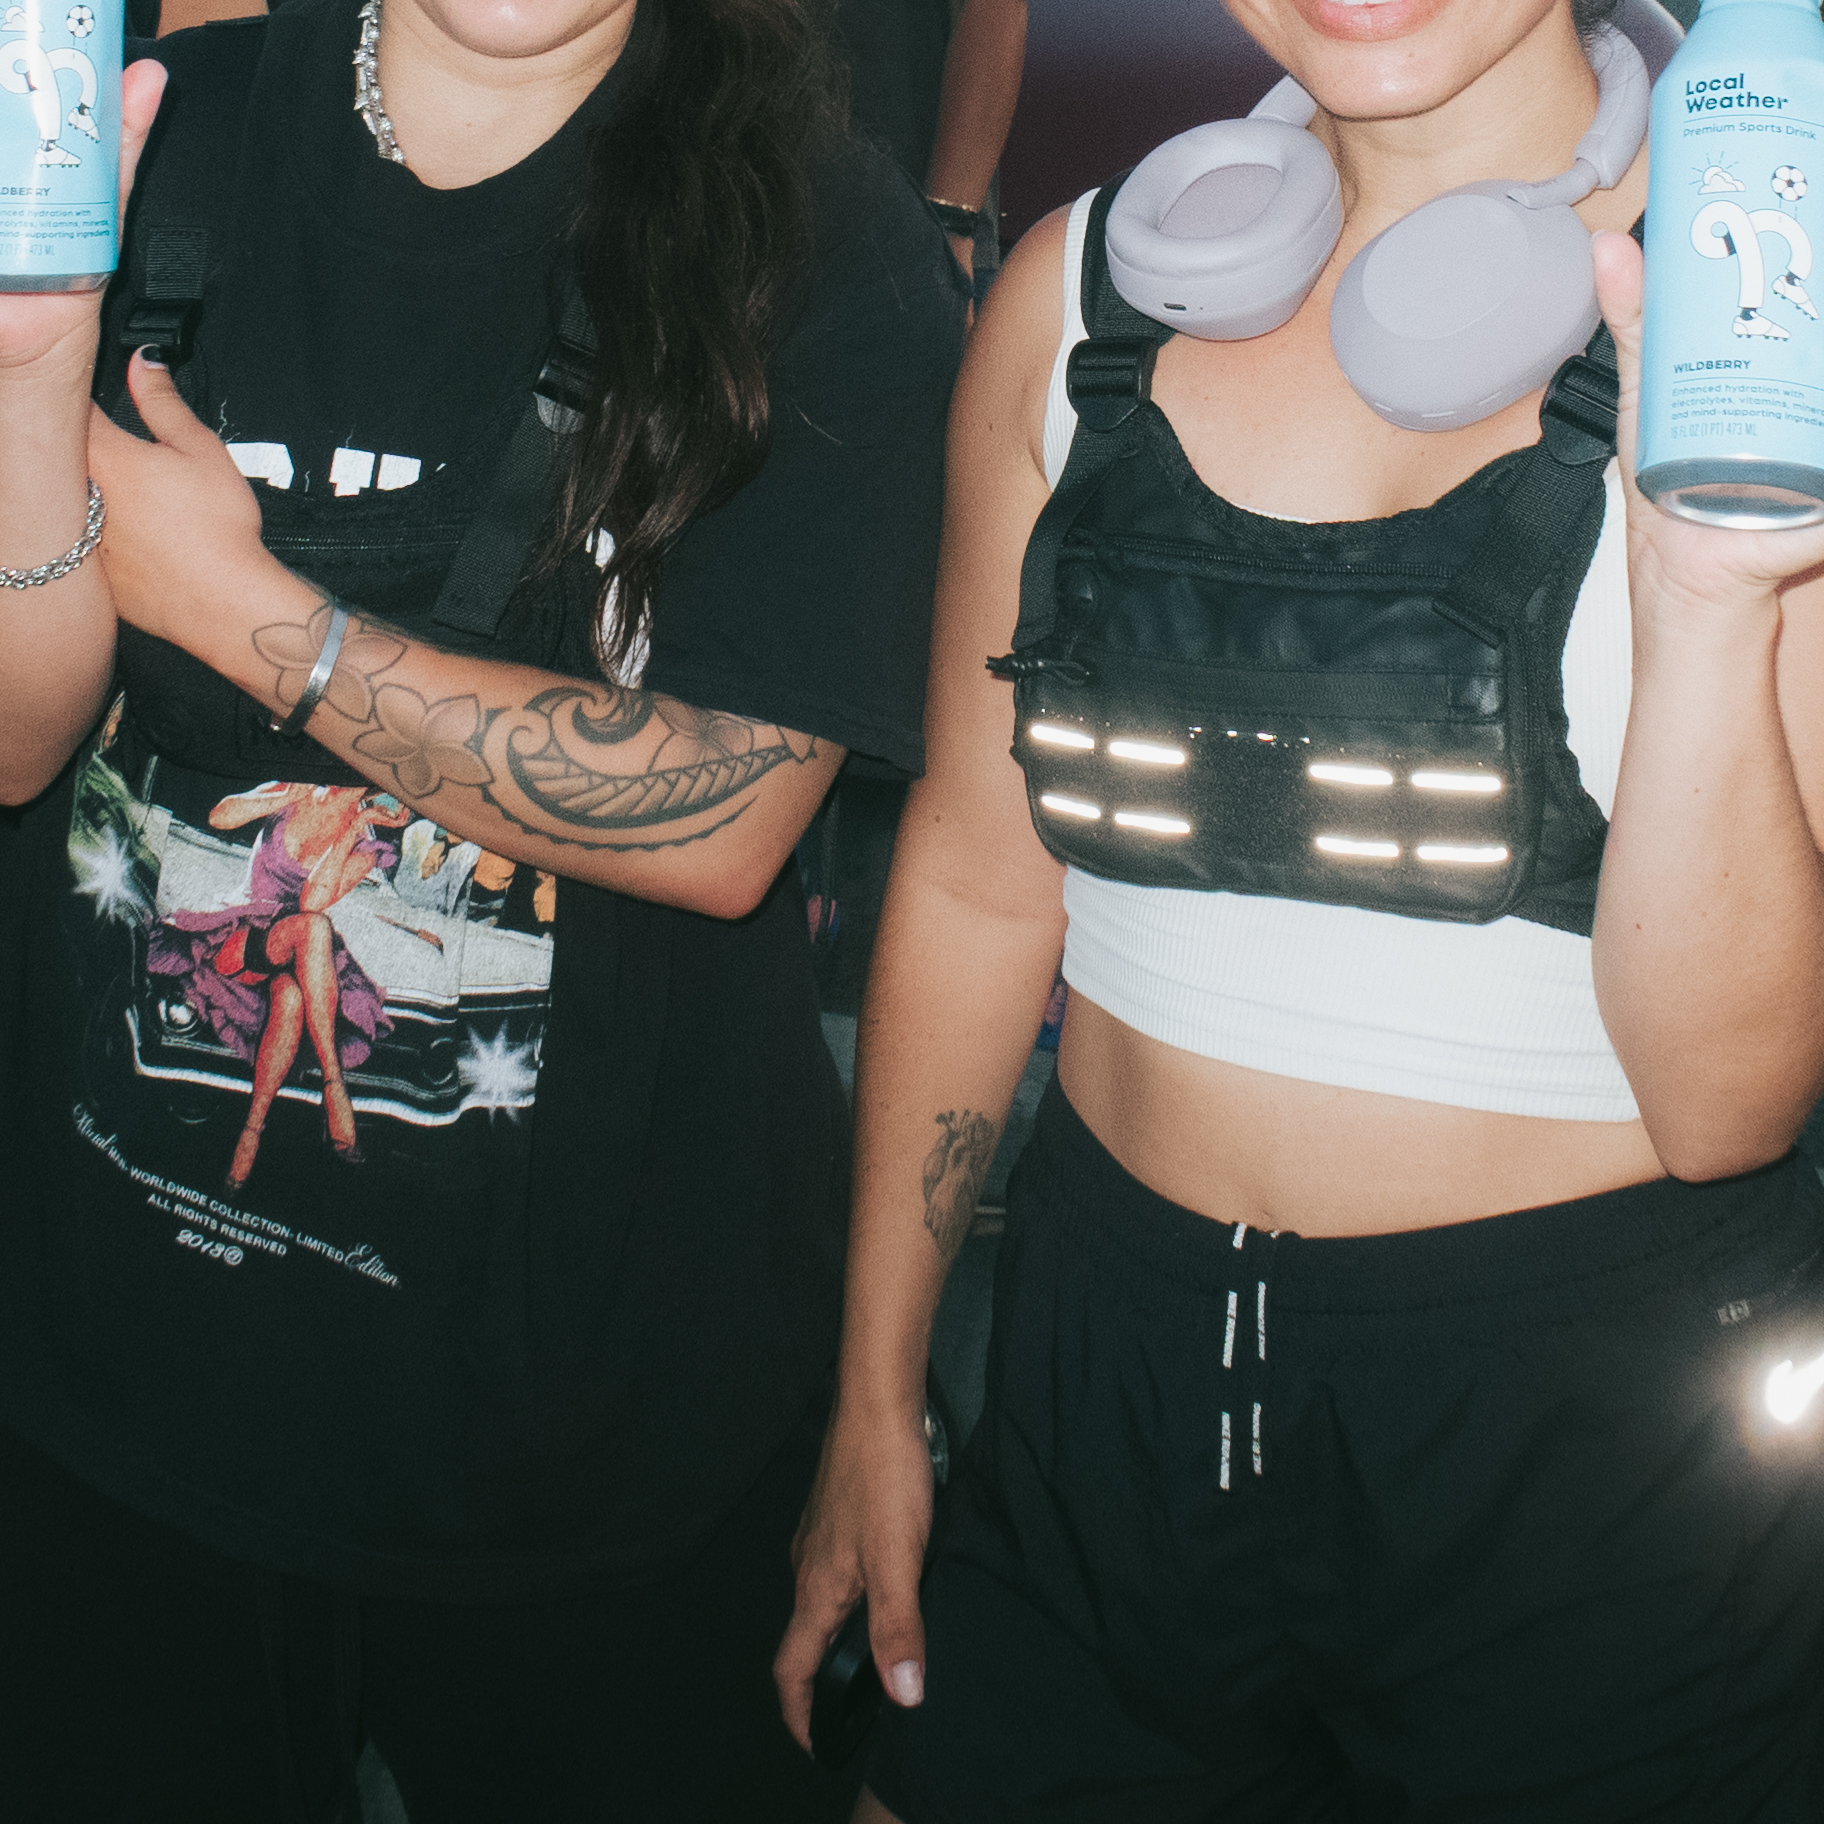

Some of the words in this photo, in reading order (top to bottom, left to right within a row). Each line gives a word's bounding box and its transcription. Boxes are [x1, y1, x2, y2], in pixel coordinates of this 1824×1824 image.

[1685, 72, 1744, 96] Local
[1685, 91, 1789, 114] Weather
[1683, 123, 1735, 138] Premium
[1739, 122, 1782, 133] Sports
[1785, 125, 1817, 141] Drink
[1673, 360, 1751, 374] WILDBERRY
[1672, 384, 1722, 397] Enhanced
[1725, 384, 1780, 396] hydration
[1782, 388, 1805, 400] with
[1671, 410, 1689, 421] and
[1726, 422, 1743, 437] 473
[1745, 422, 1758, 437] ML
[130, 1165, 208, 1207] WORLDWIDE
[295, 1231, 345, 1263] LIMITED
[147, 1193, 171, 1212] ALL
[173, 1202, 218, 1231] RIGHTS
[220, 1223, 288, 1258] RESERVED
